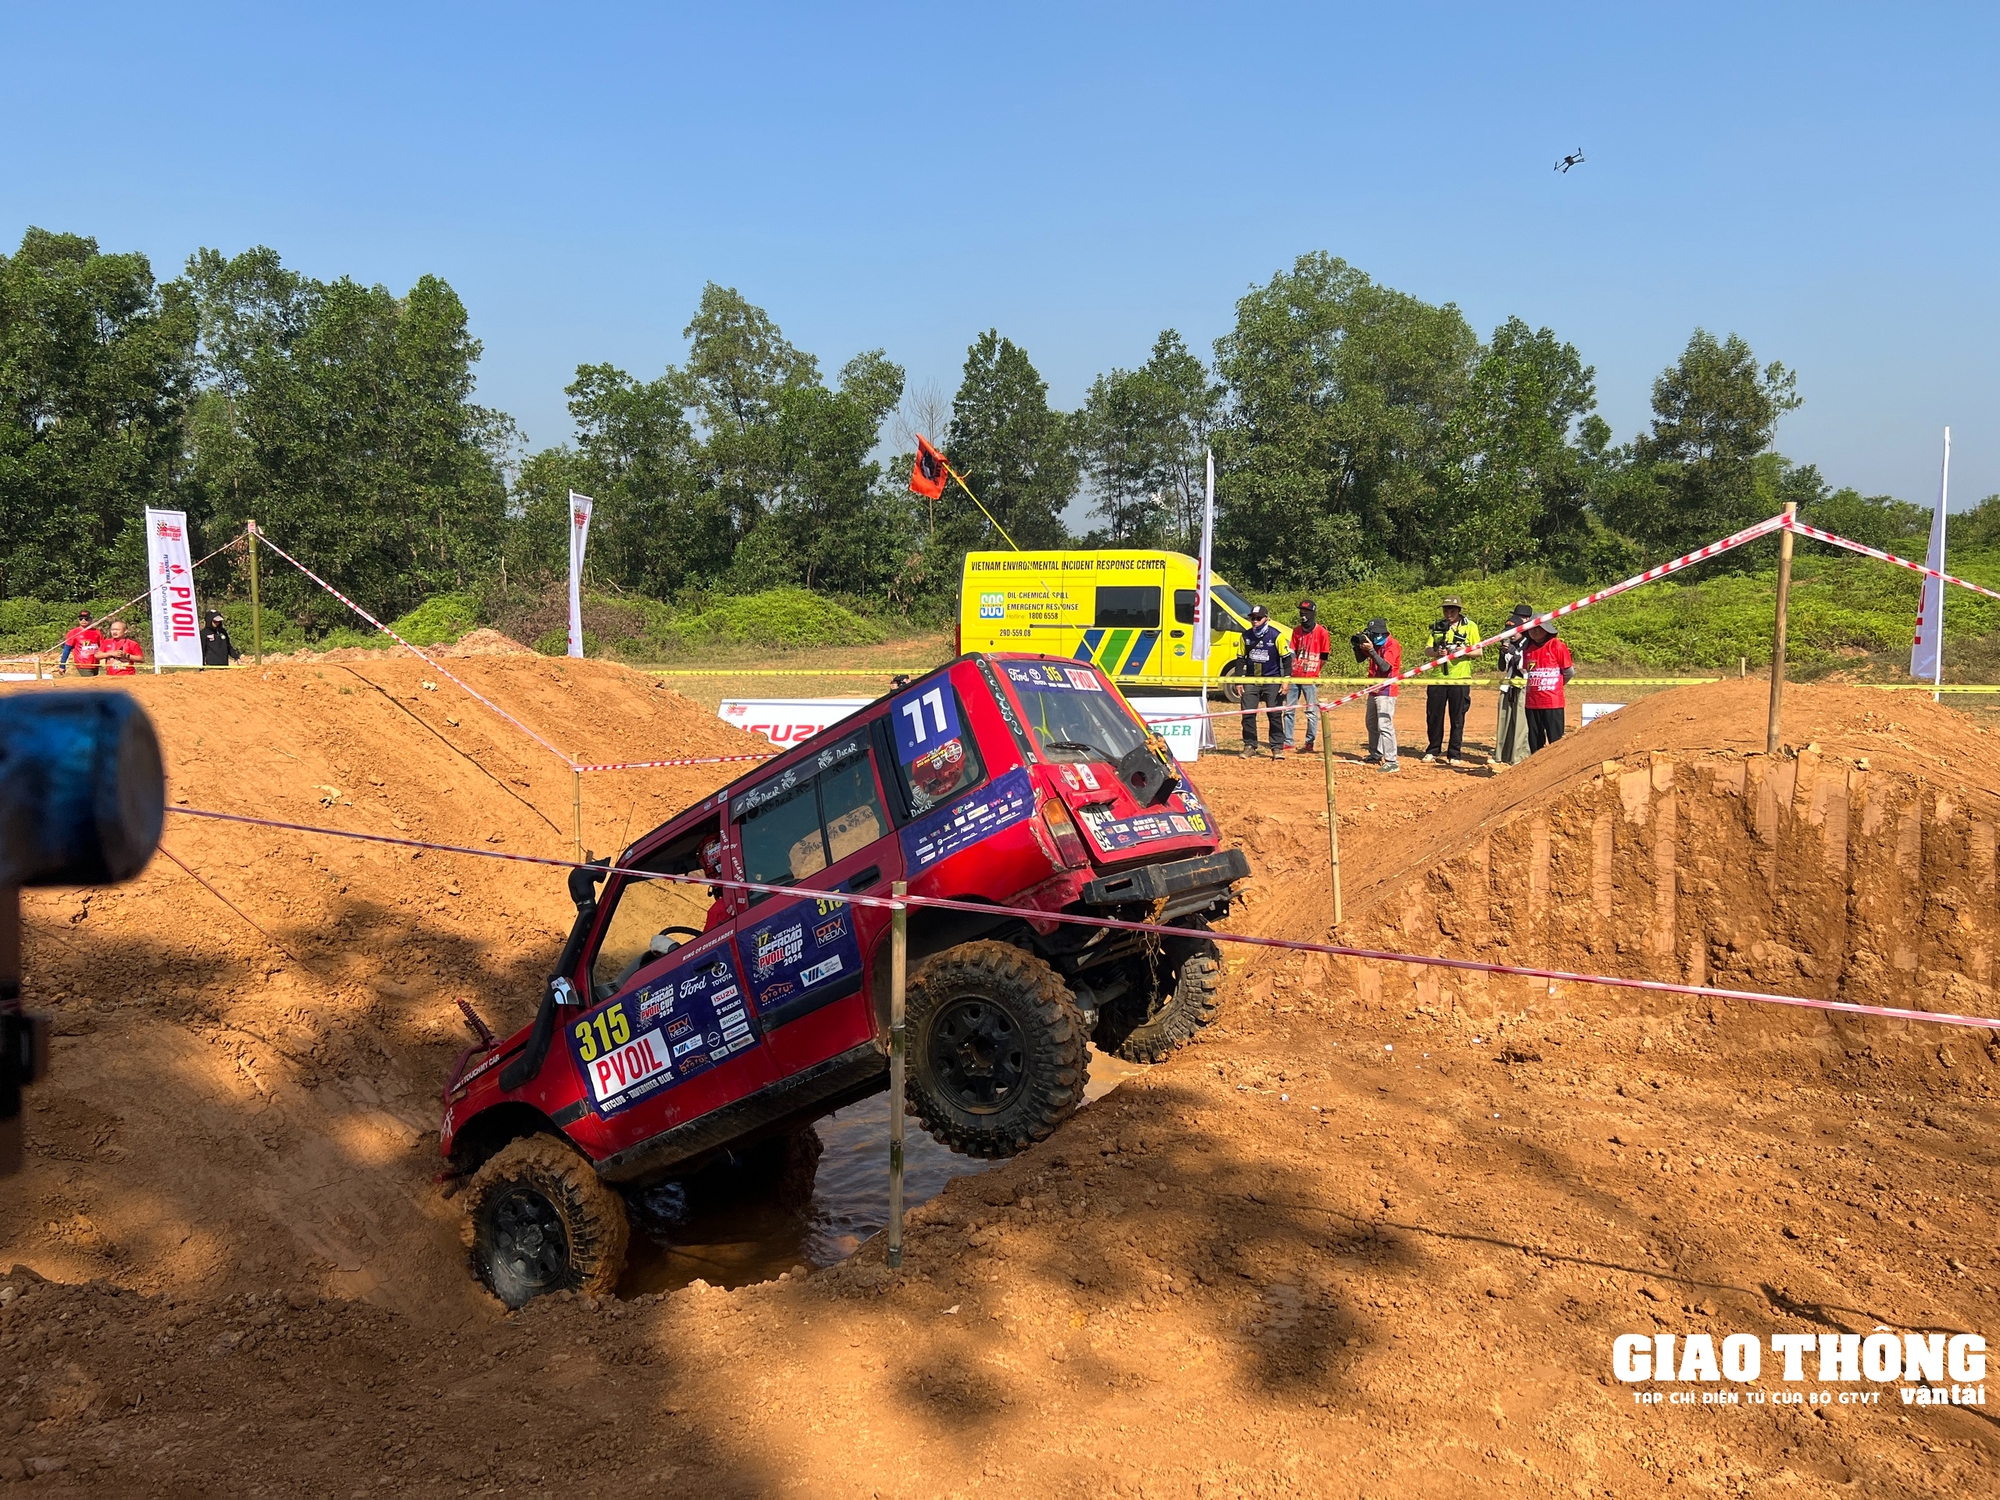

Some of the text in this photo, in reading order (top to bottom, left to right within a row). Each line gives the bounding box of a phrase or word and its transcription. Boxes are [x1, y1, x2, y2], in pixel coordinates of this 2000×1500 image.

[972, 561, 1001, 571] VIETNAM
[1062, 560, 1094, 570] INCIDENT
[1096, 560, 1134, 570] RESPONSE
[1137, 560, 1166, 570] CENTER
[170, 586, 195, 642] PVOIL
[1029, 612, 1042, 620] 1800
[1044, 612, 1058, 620] 6558
[772, 922, 801, 940] VIETNAM
[758, 933, 769, 946] 17
[758, 928, 802, 957] OFFROAD
[758, 938, 803, 969] PVOIL CUP
[784, 952, 802, 966] 2024
[680, 975, 707, 998] Ford
[712, 973, 733, 987] TOYOTA
[640, 992, 649, 1002] 17
[640, 988, 674, 1010] OFFROAD
[714, 988, 736, 1002] ISUZU
[640, 996, 674, 1021] PVOIL CUP
[659, 1006, 674, 1018] 2024
[722, 1000, 742, 1012] SUZUKI
[576, 1003, 630, 1062] 315
[488, 1054, 500, 1066] CAR
[596, 1038, 663, 1095] PVOIL
[658, 1071, 675, 1086] BLUE
